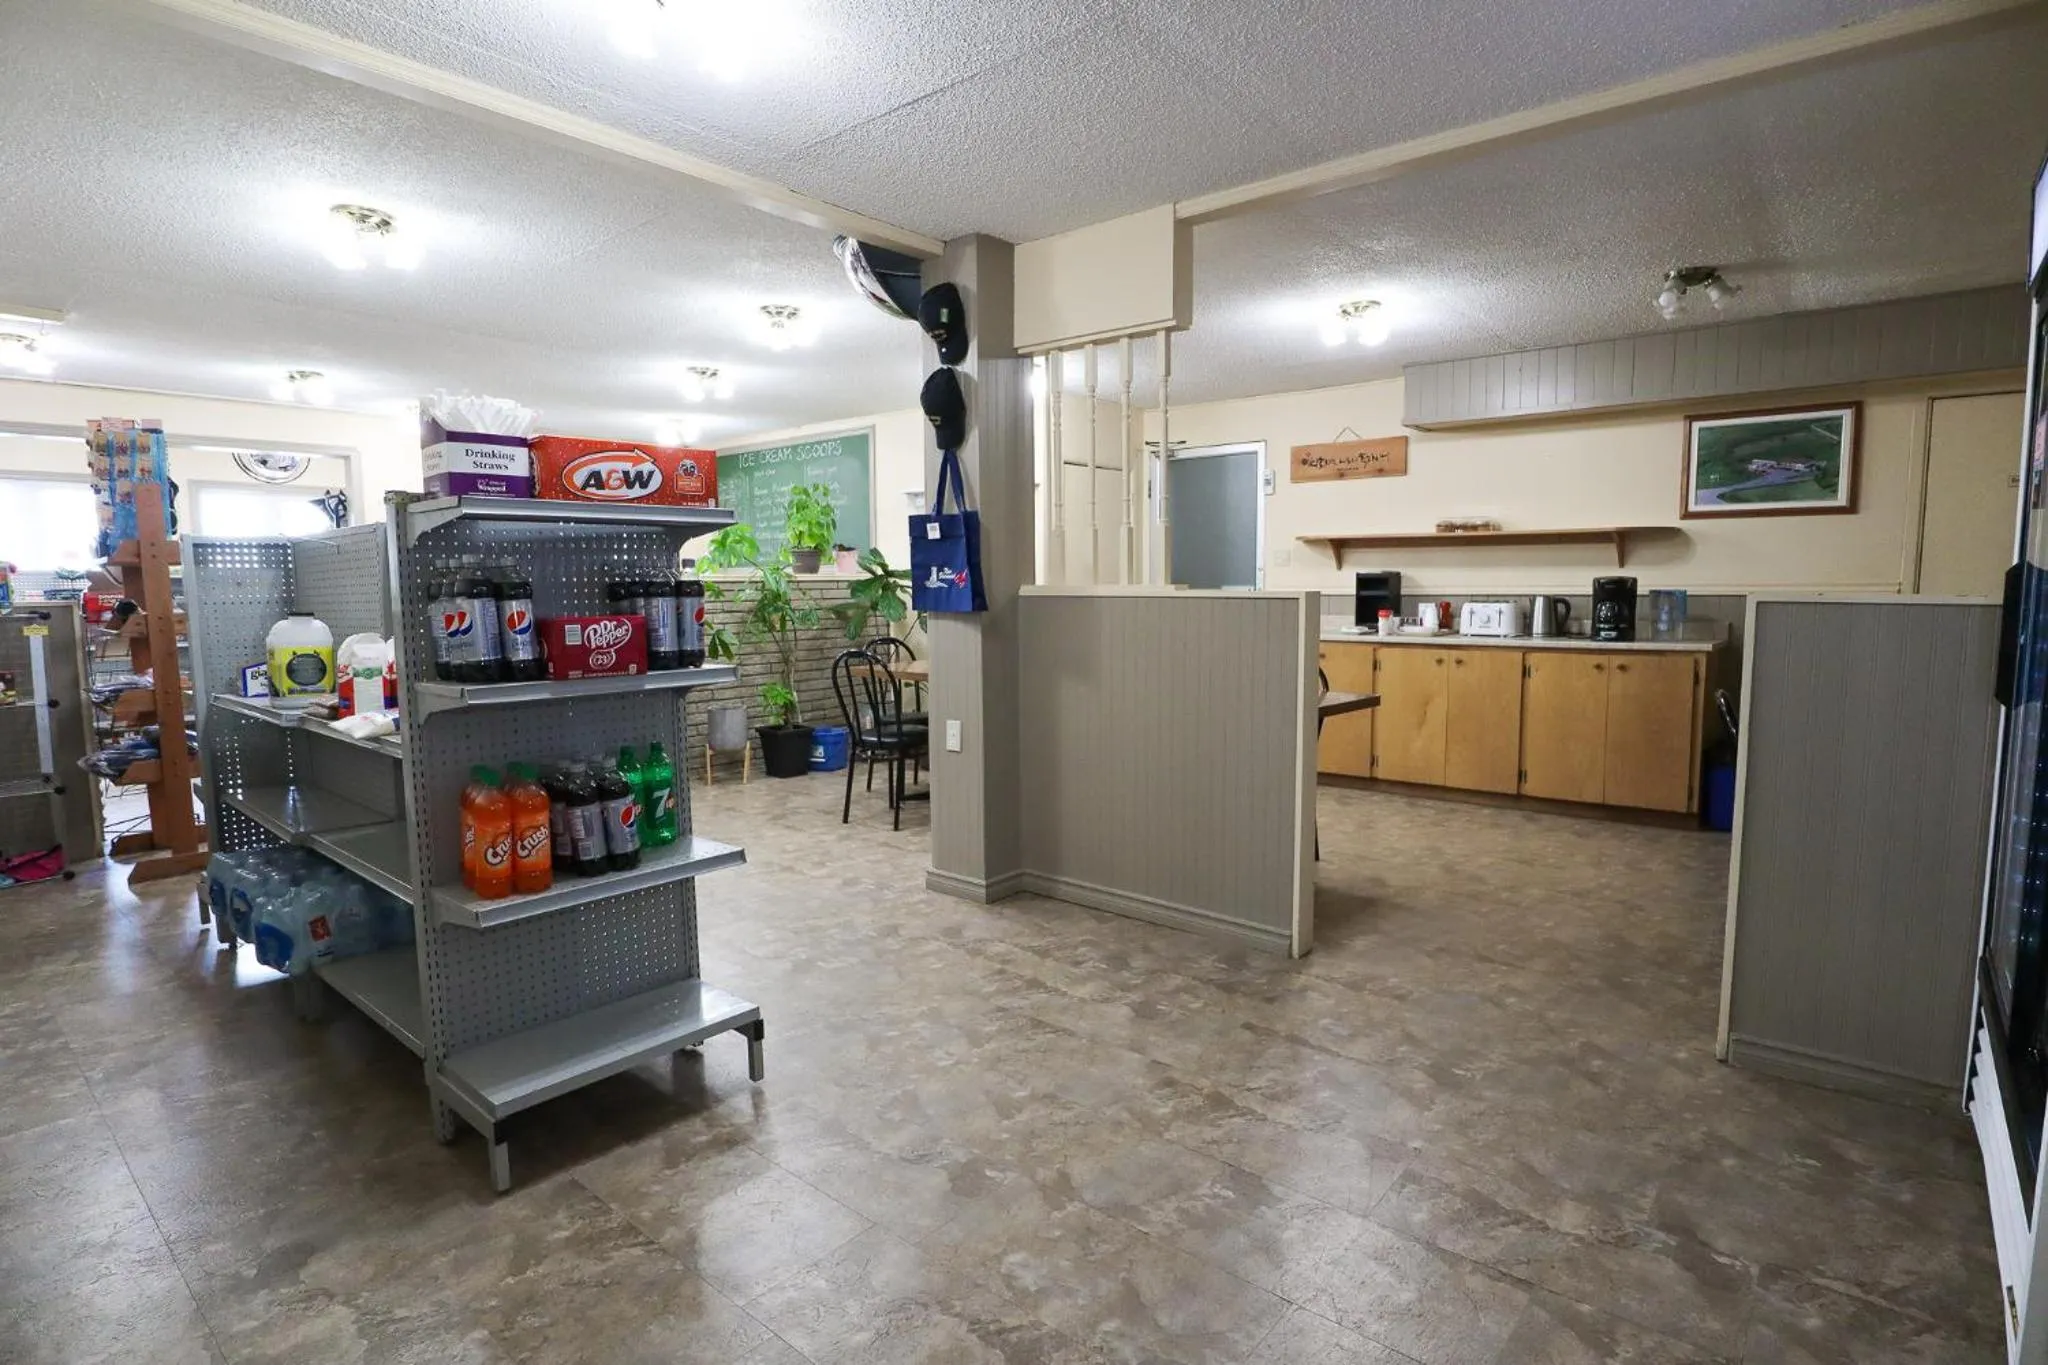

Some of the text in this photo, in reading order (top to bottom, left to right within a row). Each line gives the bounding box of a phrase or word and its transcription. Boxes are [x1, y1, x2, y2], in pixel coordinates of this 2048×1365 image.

[464, 448, 516, 462] Drinking
[472, 460, 509, 471] Straws
[738, 440, 843, 469] ICE CREAM SCOOPS
[580, 468, 656, 491] A&W
[589, 623, 629, 649] Pepper
[601, 620, 618, 633] Dr
[516, 825, 549, 858] Crush
